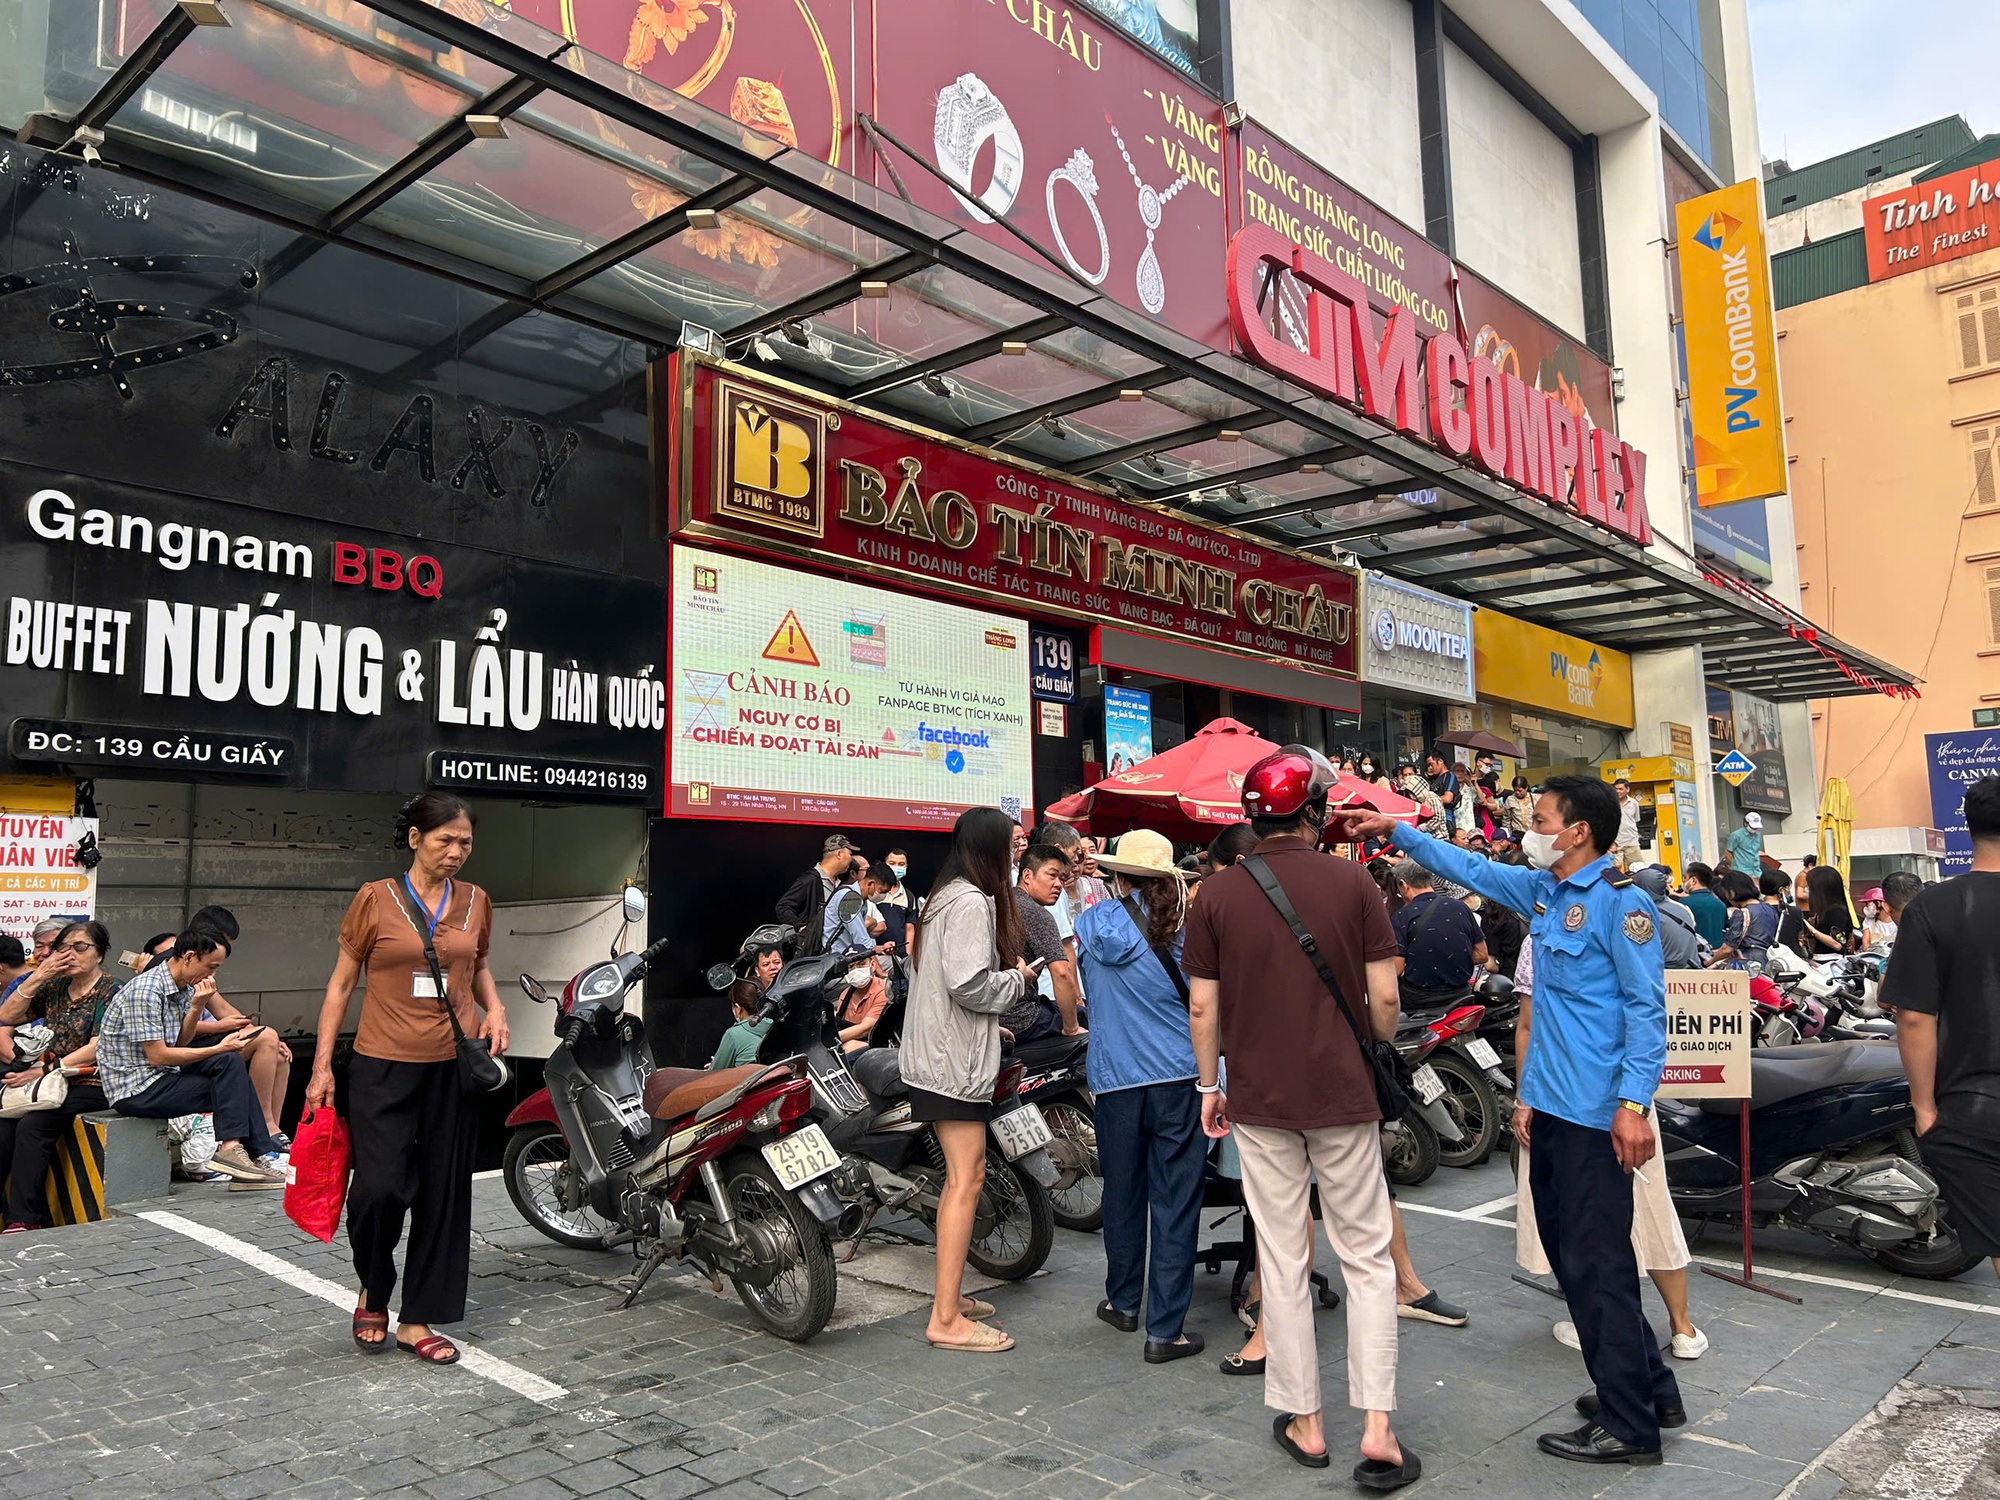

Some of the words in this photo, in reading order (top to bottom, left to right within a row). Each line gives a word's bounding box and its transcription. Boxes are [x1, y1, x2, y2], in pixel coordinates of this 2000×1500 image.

[1160, 91, 1219, 153] VÀNG
[1246, 144, 1300, 204] RỒNG
[1302, 183, 1360, 241] THĂNG
[1363, 223, 1405, 270] LONG
[1880, 190, 1957, 233] Tinh
[1161, 136, 1220, 197] VÀNG
[1247, 189, 1301, 244] TRANG
[1304, 224, 1334, 264] SỨC
[1336, 246, 1372, 288] CHẤT
[1375, 272, 1420, 316] LƯỢNG
[1422, 298, 1448, 332] CAO
[1886, 245, 1919, 264] The
[1932, 223, 1988, 256] finest
[1427, 333, 1653, 547] COMPLEX
[734, 487, 773, 511] BTMC
[778, 500, 811, 521] 1989
[996, 475, 1039, 501] CÔNG
[1044, 489, 1061, 506] TY
[1064, 494, 1100, 519] TNHH
[1104, 506, 1137, 530] VÀNG
[1139, 519, 1164, 538] BẠC
[1168, 526, 1184, 544] ĐÁ
[1239, 549, 1262, 568] LTD)
[25, 488, 314, 578] Gangnam
[333, 540, 444, 600] BBQ
[836, 455, 979, 550] BẢO
[988, 503, 1094, 583] TÍN
[1099, 535, 1237, 619] MINH
[1240, 579, 1352, 646] CHÂU
[857, 537, 901, 562] KINH
[907, 550, 963, 577] DOANH
[967, 562, 997, 586] CHẾ
[1003, 570, 1030, 593] TÁC
[1035, 581, 1081, 605] TRANG
[1085, 589, 1111, 613] SỨC
[1118, 598, 1148, 621] VÀNG
[1151, 610, 1174, 630] BẠC
[1184, 614, 1198, 632] ĐÁ
[1200, 619, 1222, 637] QUÝ
[1235, 629, 1252, 644] KIM
[1295, 643, 1309, 657] MỸ
[1311, 647, 1333, 665] NGHỆ
[1034, 635, 1072, 671] 139
[1400, 622, 1443, 654] MOON
[1444, 633, 1470, 659] TEA
[6, 596, 131, 676] BUFFET
[143, 592, 384, 716] NƯỚNG
[399, 648, 425, 702] &
[438, 608, 543, 732] LẨU
[551, 658, 598, 725] HÀN
[607, 664, 666, 731] QUỐC
[727, 667, 797, 699] CẢNH
[803, 680, 851, 706] BÁO
[899, 681, 914, 692] TỪ
[916, 683, 947, 698] HÀNH
[950, 690, 960, 700] VI
[962, 690, 980, 704] GIẢ
[982, 695, 1005, 708] MẠO
[1035, 672, 1052, 691] CẦU
[1054, 675, 1073, 694] GIẤY
[1567, 681, 1595, 708] Bank
[738, 707, 790, 727] NGUY
[794, 714, 819, 730] CƠ
[825, 718, 841, 737] BỊ
[878, 695, 930, 712] FANPAGE
[933, 704, 962, 716] BTMC
[964, 706, 990, 721] (TÍCH
[993, 711, 1023, 726] XANH)
[27, 731, 82, 754] ĐC:
[94, 736, 143, 758] 139
[152, 735, 212, 763] CẦU
[220, 740, 285, 767] GIẤY
[692, 726, 754, 747] CHIẾM
[760, 734, 811, 755] ĐOẠT
[815, 736, 842, 756] TÀI
[846, 740, 879, 760] SẢN
[918, 721, 989, 749] facebook
[441, 760, 539, 785] HOTLINE:
[544, 768, 648, 791] 0944216139
[1722, 761, 1745, 770] ATM
[25, 876, 46, 888] CÁC
[50, 879, 60, 891] VỊ
[64, 876, 80, 888] TRÍ
[23, 915, 39, 925] VỤ
[33, 898, 57, 908] BÀN
[65, 900, 87, 908] BAR
[1700, 980, 1738, 995] CHÂU
[1668, 1007, 1702, 1034] IỄN
[1709, 1010, 1742, 1035] PHÍ
[1680, 1041, 1705, 1051] GIAO
[1708, 1041, 1731, 1054] DỊCH
[590, 1118, 615, 1128] HONDA
[1007, 1126, 1046, 1156] 7518
[785, 1150, 832, 1184] 6782
